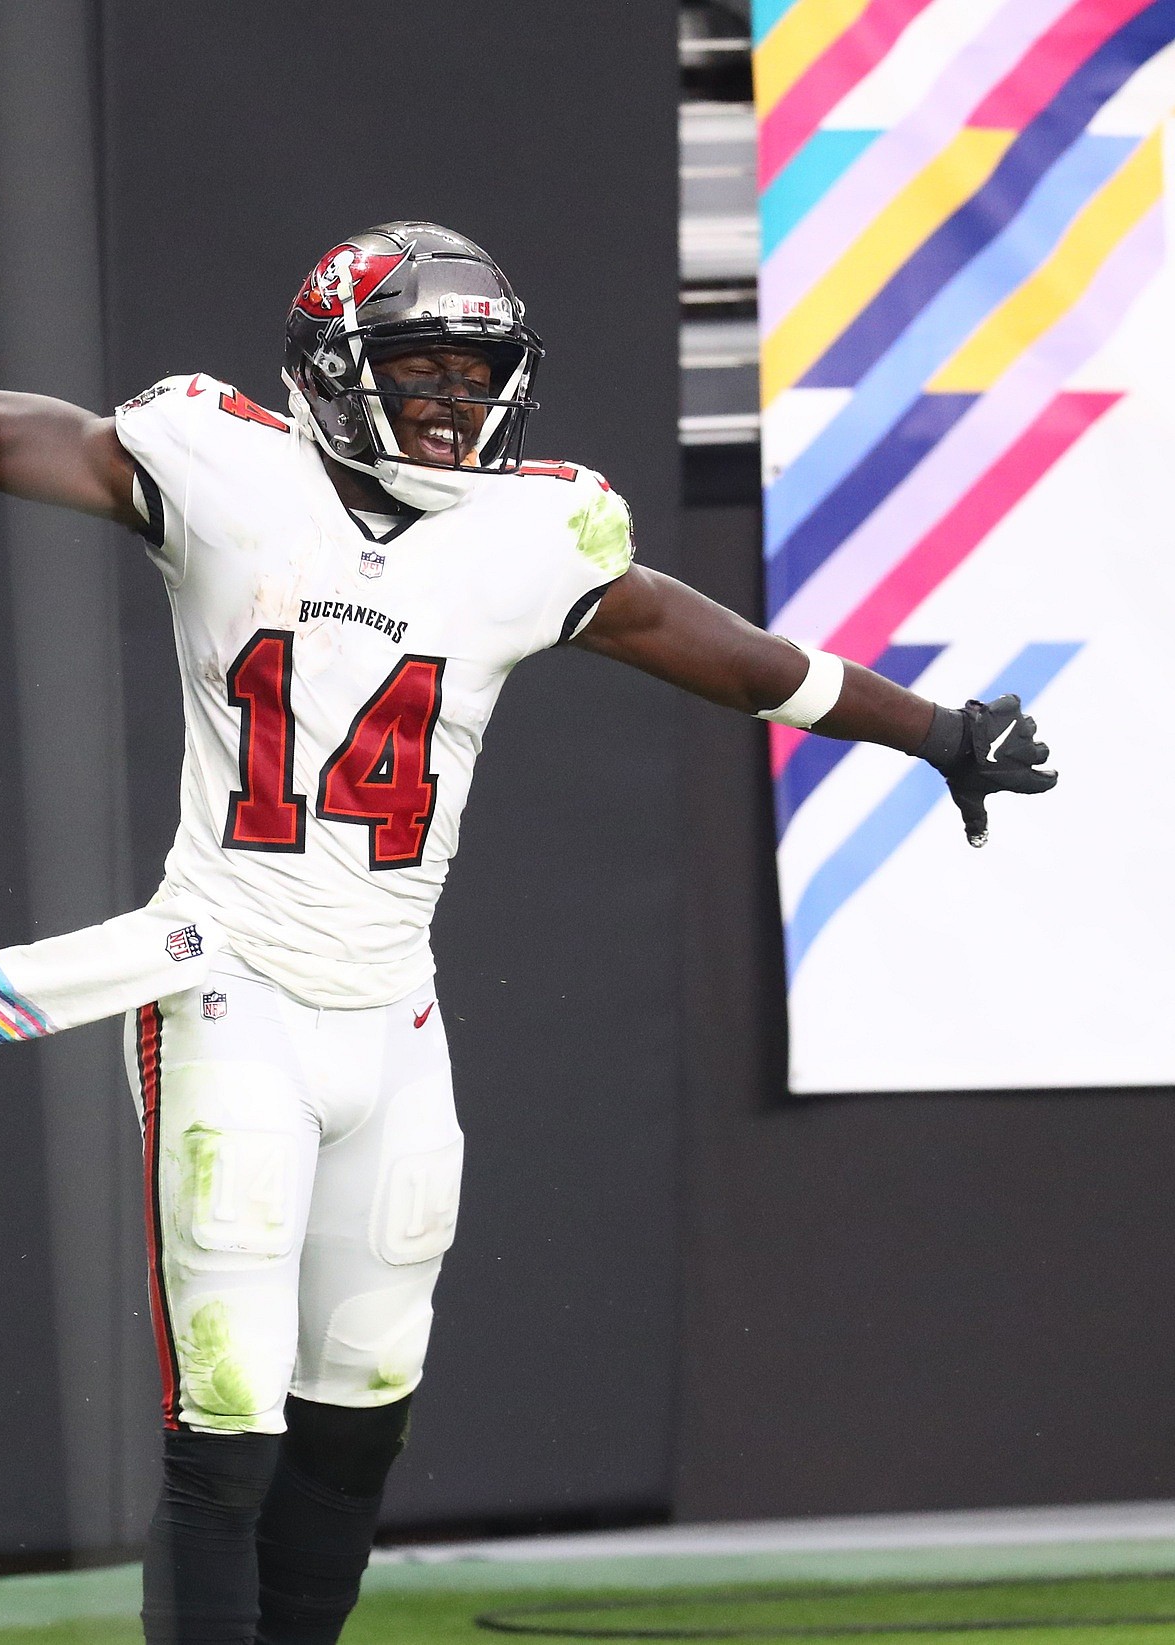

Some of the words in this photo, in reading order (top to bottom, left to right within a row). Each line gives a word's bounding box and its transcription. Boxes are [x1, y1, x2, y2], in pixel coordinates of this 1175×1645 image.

[298, 599, 409, 644] BUCCANEERS
[221, 628, 447, 872] 14
[168, 930, 191, 960] NFL
